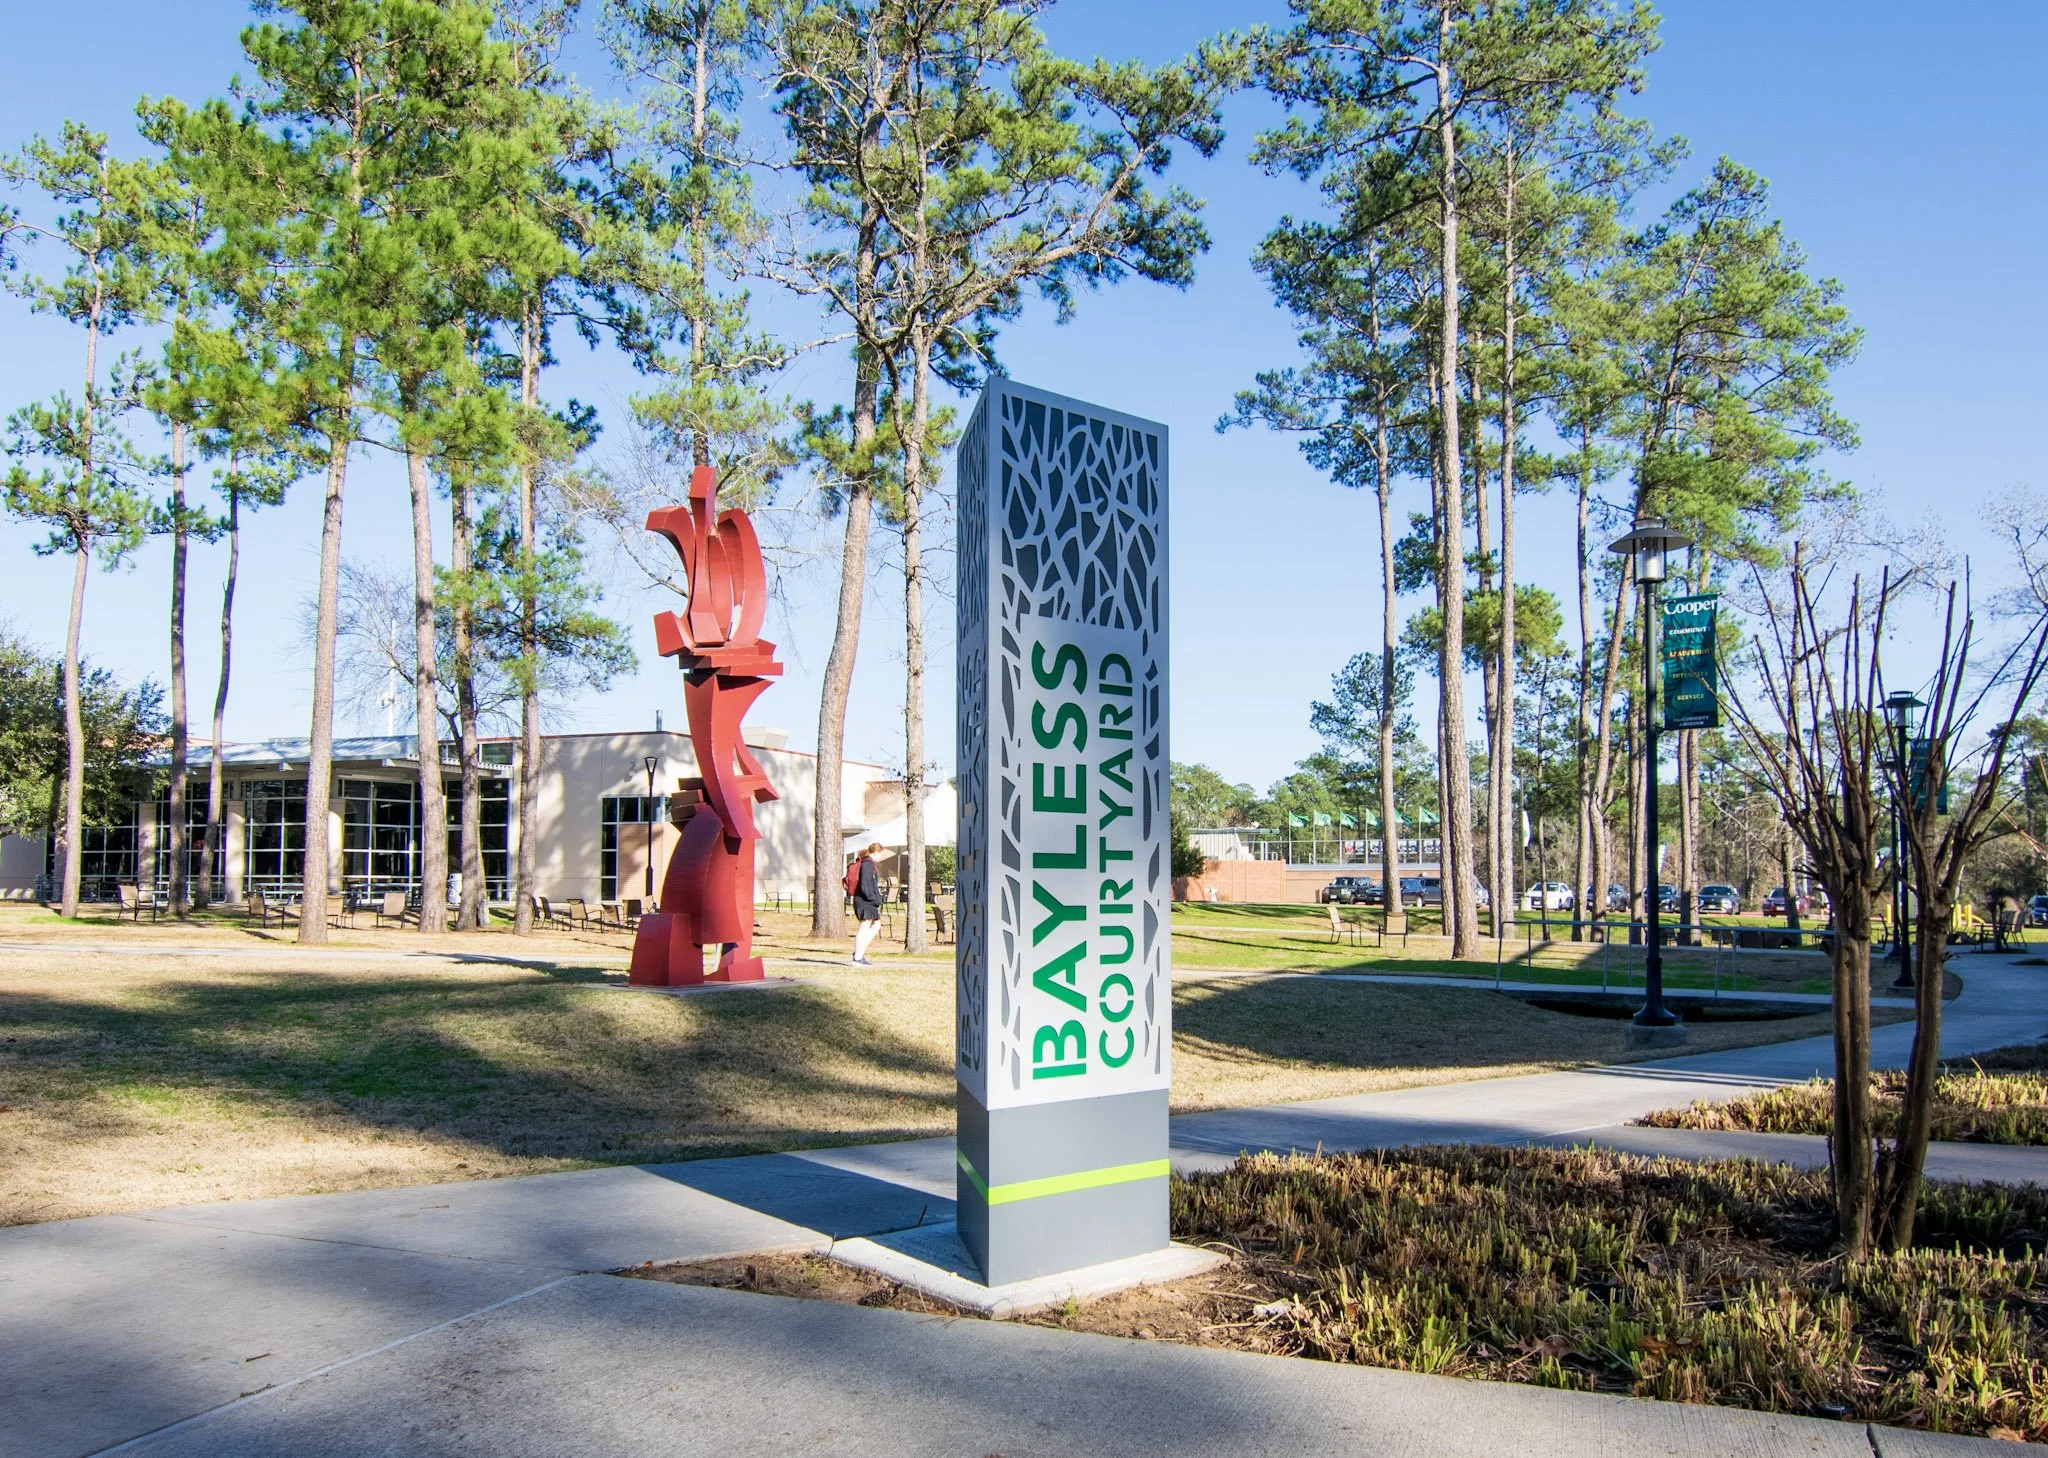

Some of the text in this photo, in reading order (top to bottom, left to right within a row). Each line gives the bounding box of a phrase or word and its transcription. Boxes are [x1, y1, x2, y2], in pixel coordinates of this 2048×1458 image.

[1664, 599, 1717, 615] Cooper
[1031, 639, 1088, 1081] BAYLESS
[1098, 652, 1135, 1069] COURTYARD
